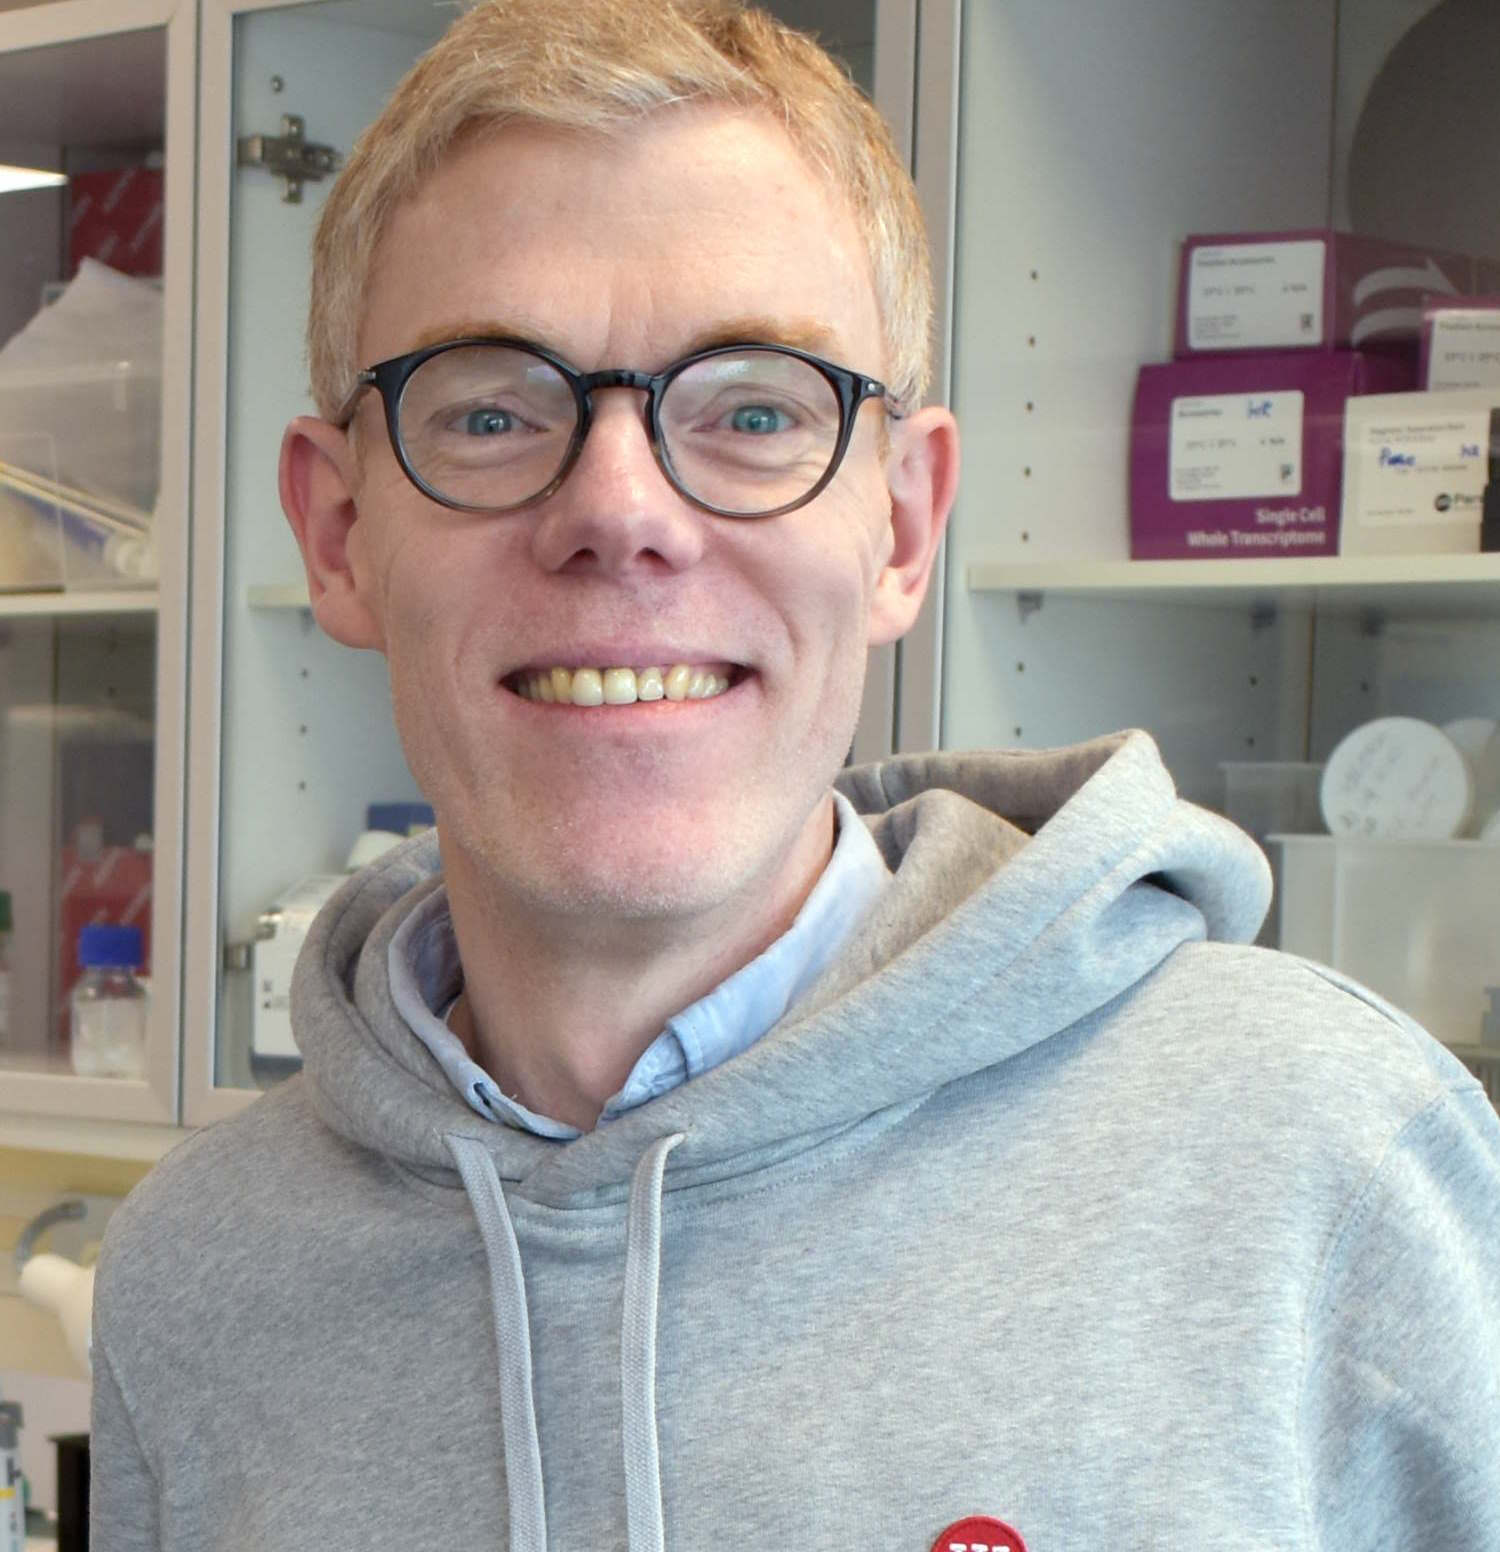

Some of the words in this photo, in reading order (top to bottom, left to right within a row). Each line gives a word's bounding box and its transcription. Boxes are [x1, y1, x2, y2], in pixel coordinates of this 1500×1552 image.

[1256, 507, 1296, 526] Single
[1300, 506, 1325, 522] Cell
[1187, 530, 1228, 546] Whole
[1231, 530, 1325, 547] Transcriptome
